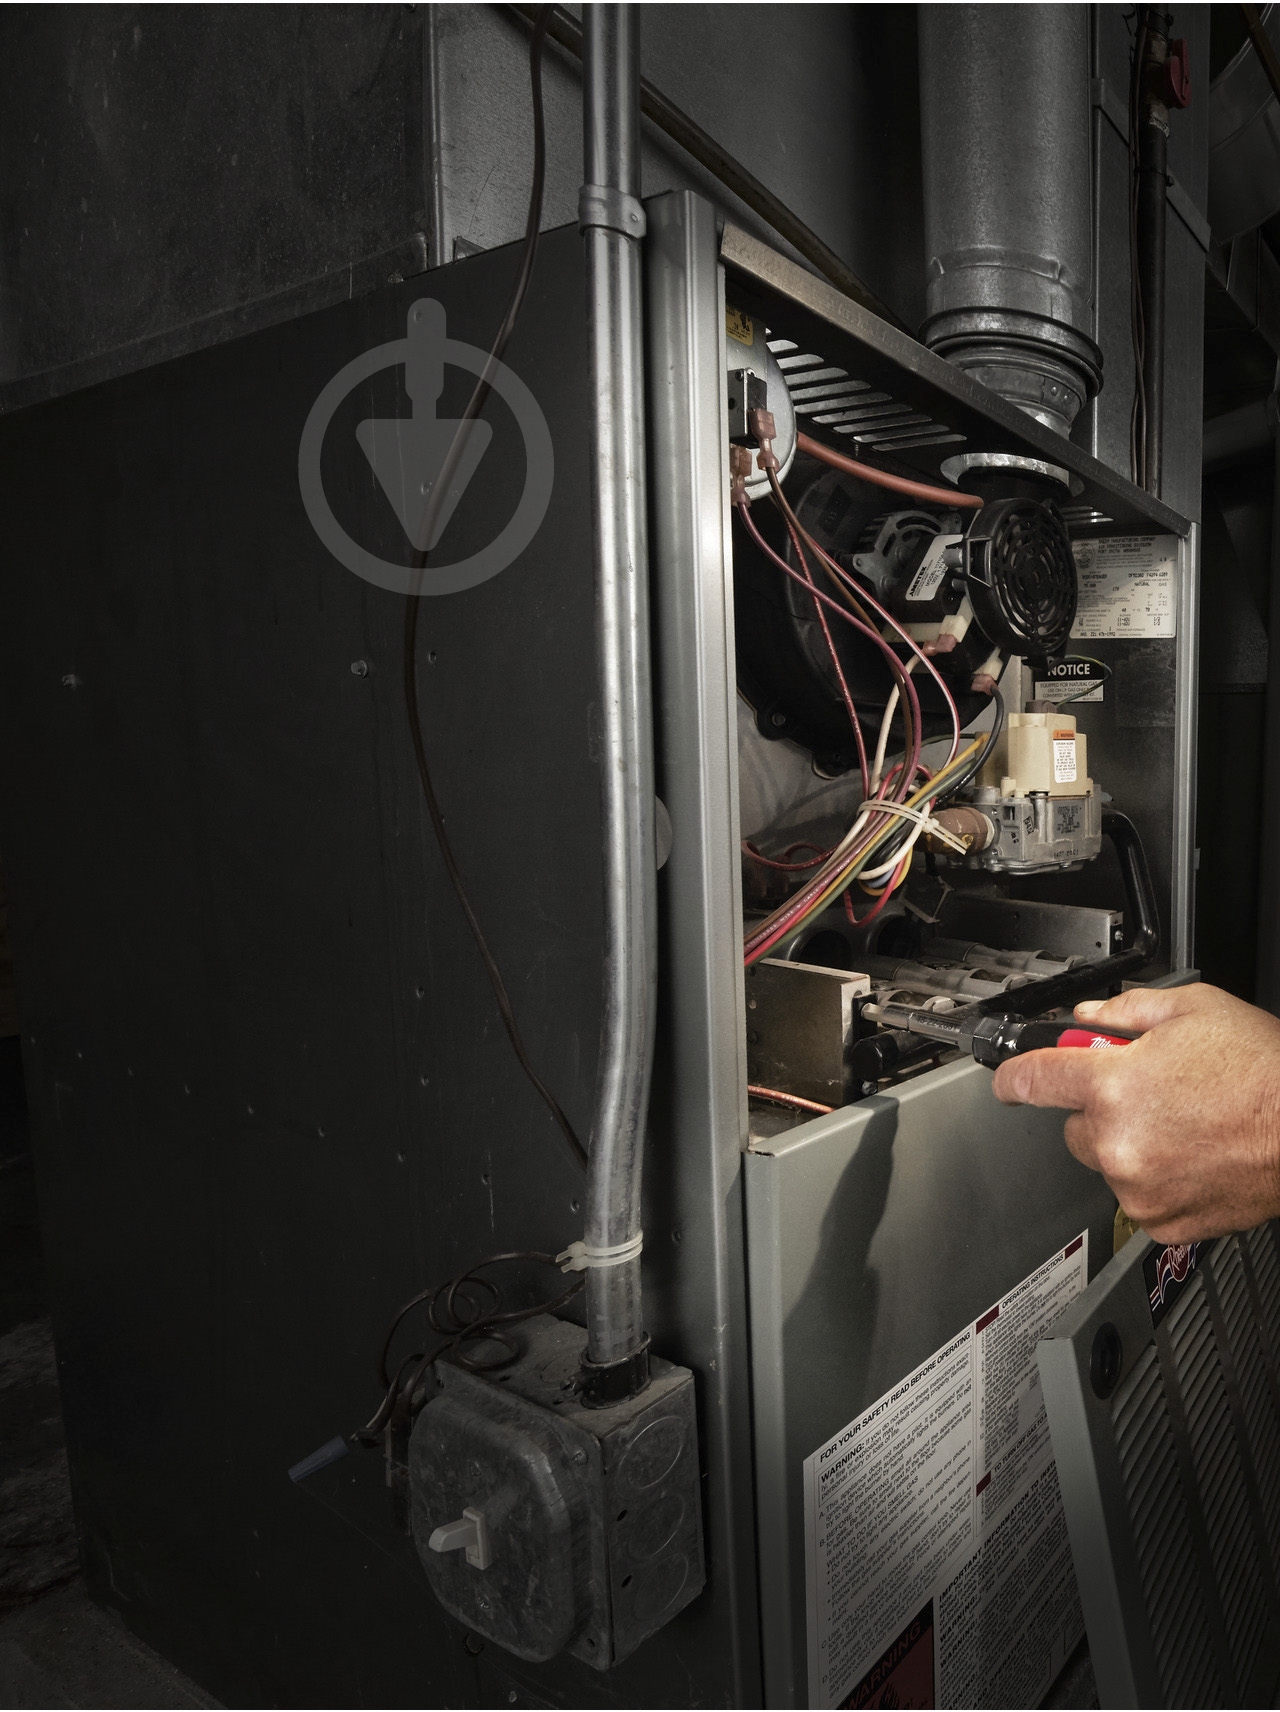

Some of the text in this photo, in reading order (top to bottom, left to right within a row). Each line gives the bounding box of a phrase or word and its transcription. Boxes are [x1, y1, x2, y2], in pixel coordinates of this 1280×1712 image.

[1047, 663, 1090, 676] NOTICE
[1002, 1254, 1064, 1309] OPERATING INSTRUCTIONS
[820, 1331, 970, 1462] FOR YOUR SAFETY READ BEFORE OPERATING
[821, 1440, 864, 1484] WARNING:
[994, 1462, 1002, 1473] TO
[1002, 1445, 1016, 1463] TURN
[1026, 1425, 1037, 1440] GAS
[1037, 1418, 1044, 1429] TO
[940, 1547, 982, 1602] IMPORTANT
[984, 1491, 1029, 1548] INFORMATION
[1031, 1480, 1039, 1492] TO
[1040, 1459, 1056, 1479] INSTA
[940, 1595, 978, 1643] WARNING:
[949, 1671, 978, 1709] ARNING:
